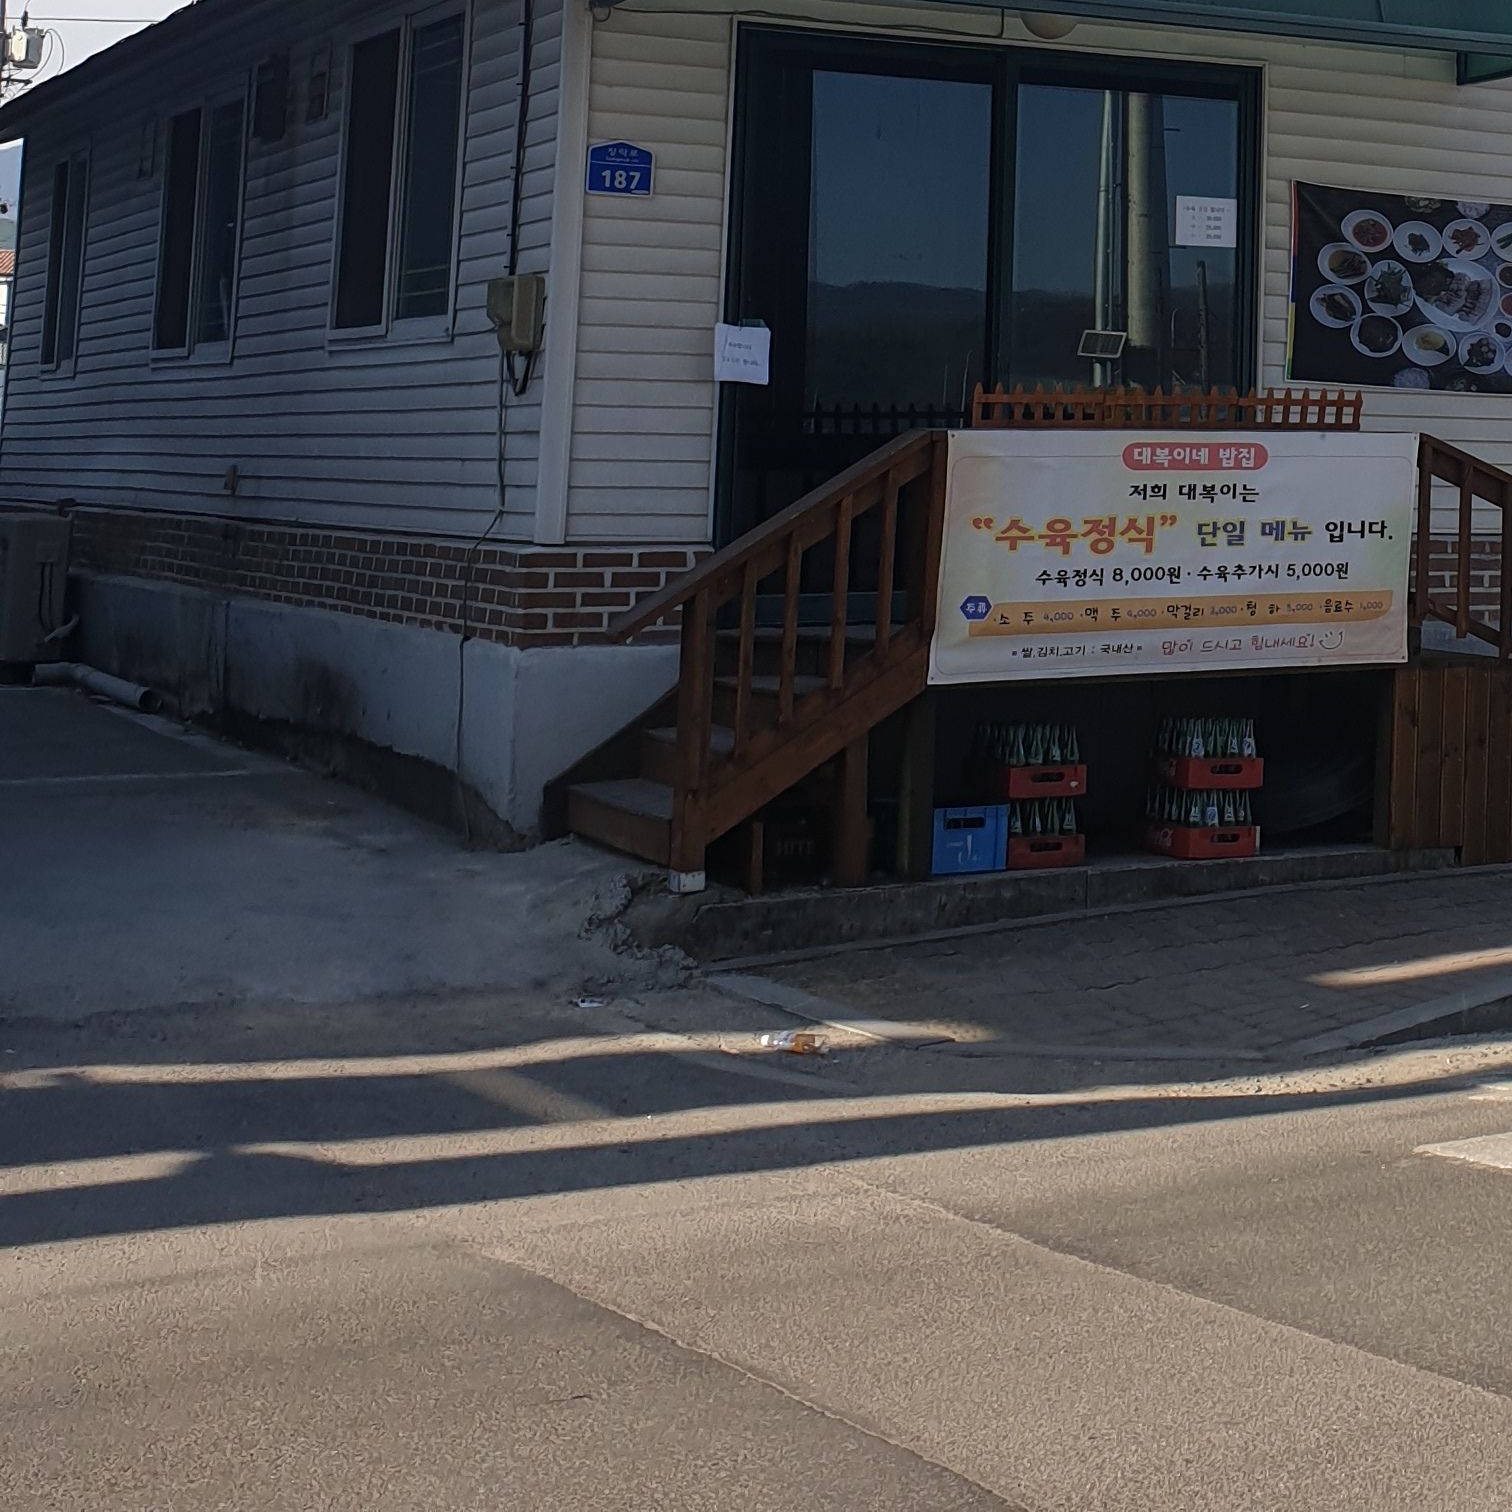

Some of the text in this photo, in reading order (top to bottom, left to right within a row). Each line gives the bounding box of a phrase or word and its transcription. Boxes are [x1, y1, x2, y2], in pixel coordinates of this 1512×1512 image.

[601, 169, 641, 190] 187
[1133, 446, 1256, 468] 대복이네 밥집
[1128, 483, 1260, 504] 저희 대복이는
[1197, 519, 1246, 548] 단일
[1260, 519, 1313, 543] 메뉴
[1325, 519, 1394, 543] 입니다.
[1035, 561, 1350, 588] 수육정식 8,000원 수육추가시 5,000원
[1166, 603, 1205, 621] 막걸리
[1323, 597, 1355, 614] 음료수
[1101, 642, 1135, 655] 국내산
[1161, 639, 1194, 656] 많이
[1200, 638, 1243, 653] 드시고
